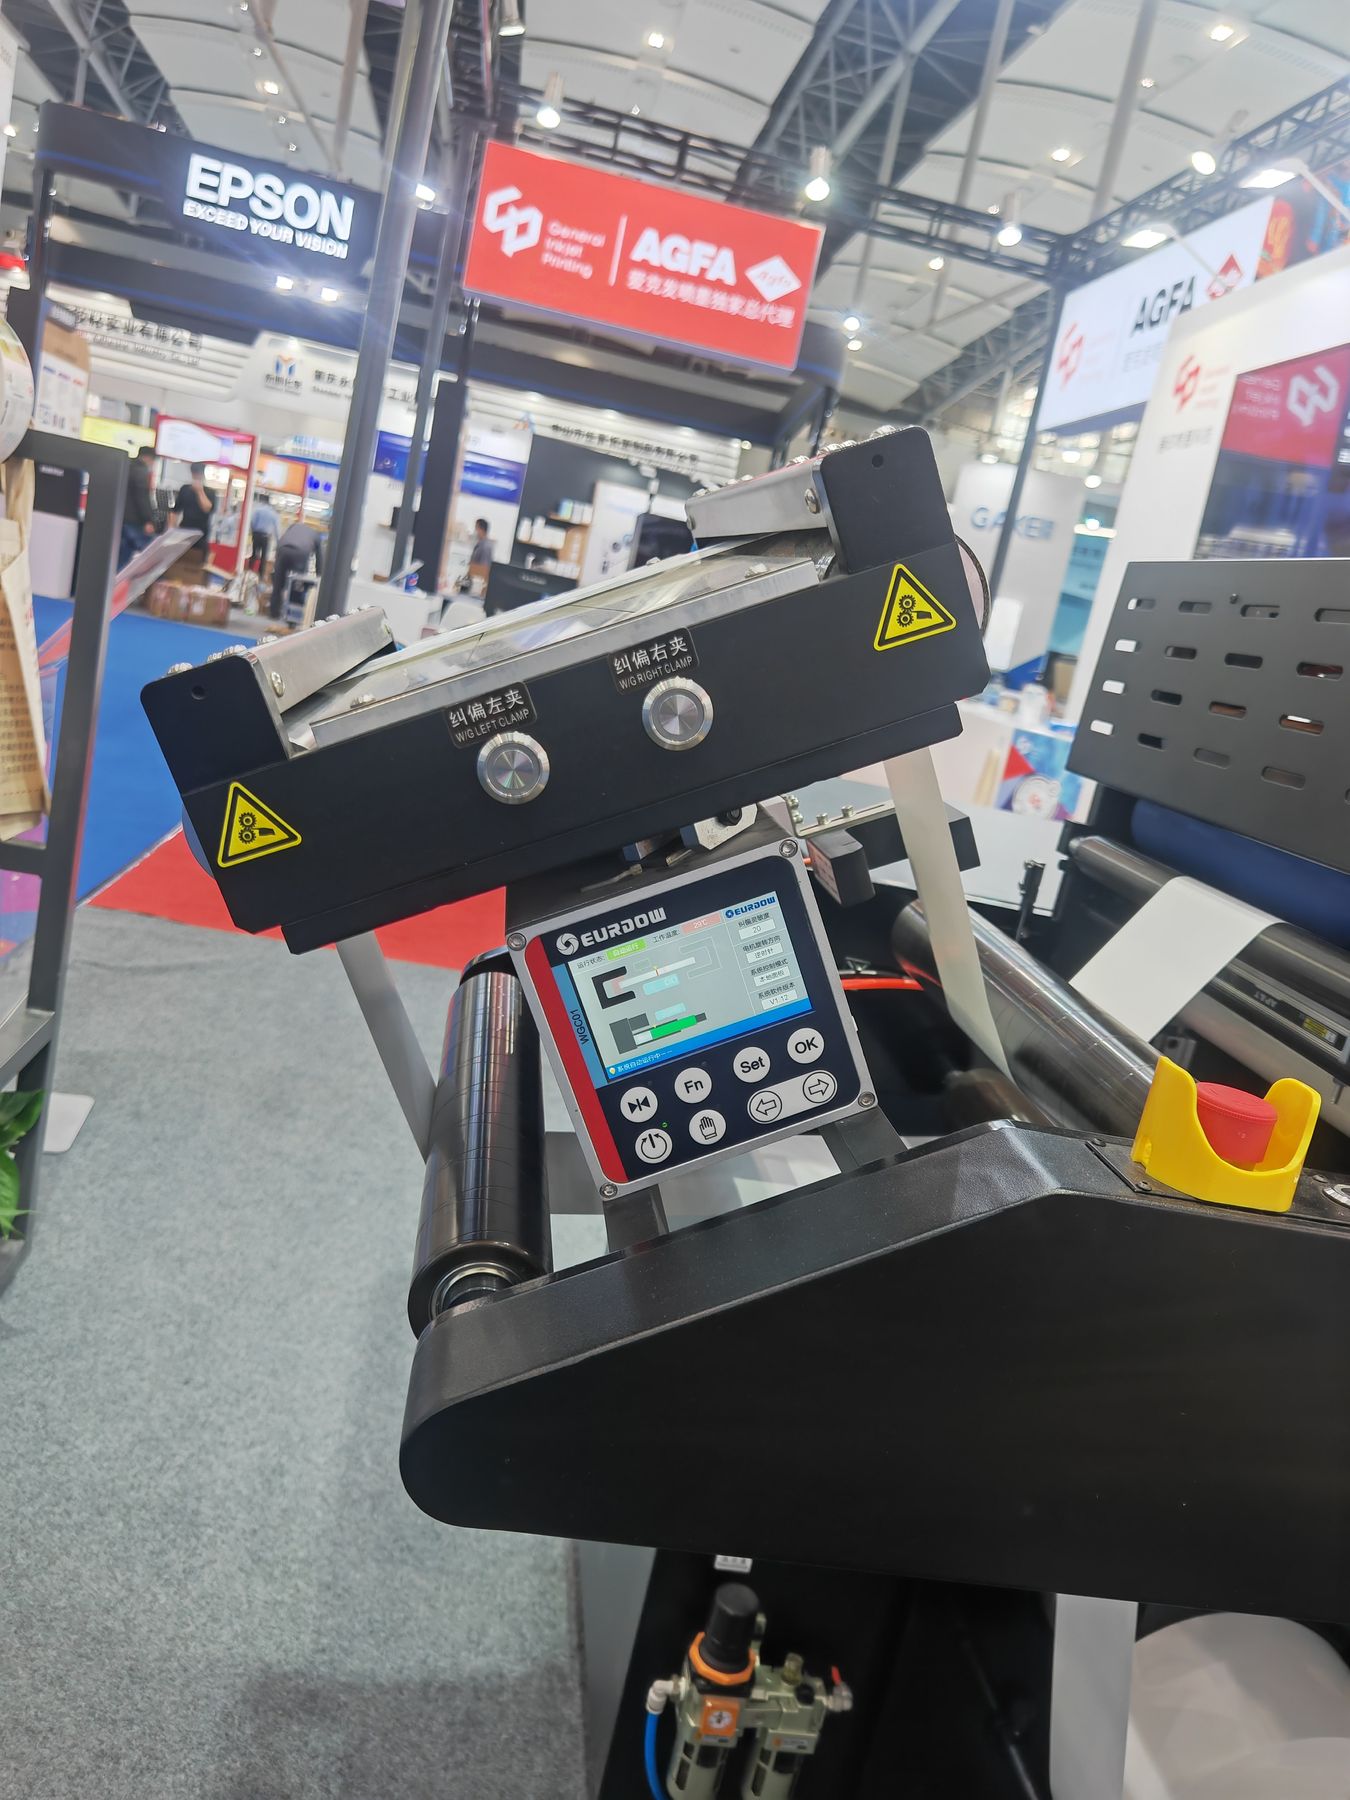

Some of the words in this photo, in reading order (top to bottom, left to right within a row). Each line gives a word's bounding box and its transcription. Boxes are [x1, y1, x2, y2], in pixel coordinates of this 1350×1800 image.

[186, 153, 354, 241] EPSON
[183, 199, 249, 231] EXCEED
[249, 218, 293, 245] YOUR
[295, 227, 348, 259] VISION
[547, 221, 606, 248] General
[541, 252, 593, 280] Printing
[630, 227, 737, 286] AGFA
[1130, 275, 1196, 338] AGFA
[614, 636, 688, 675] 纠偏右夹
[619, 674, 637, 690] W/G
[637, 667, 663, 684] RIGHT
[664, 656, 693, 675] CLAMP
[449, 689, 524, 728] 纠偏左夹
[455, 727, 475, 743] W/G
[476, 720, 497, 736] LEFT
[500, 708, 530, 728] CLAMP
[735, 896, 776, 916] EURDOW
[581, 907, 667, 947] EURDOW
[752, 925, 761, 934] 20
[743, 935, 781, 952] 电机旋转方向
[751, 959, 789, 976] 系统控制模式
[758, 982, 796, 999] 系统软件版本
[570, 1009, 590, 1045] WGC01
[794, 1036, 819, 1054] OK
[740, 1056, 764, 1073] Set
[684, 1078, 704, 1094] Fn
